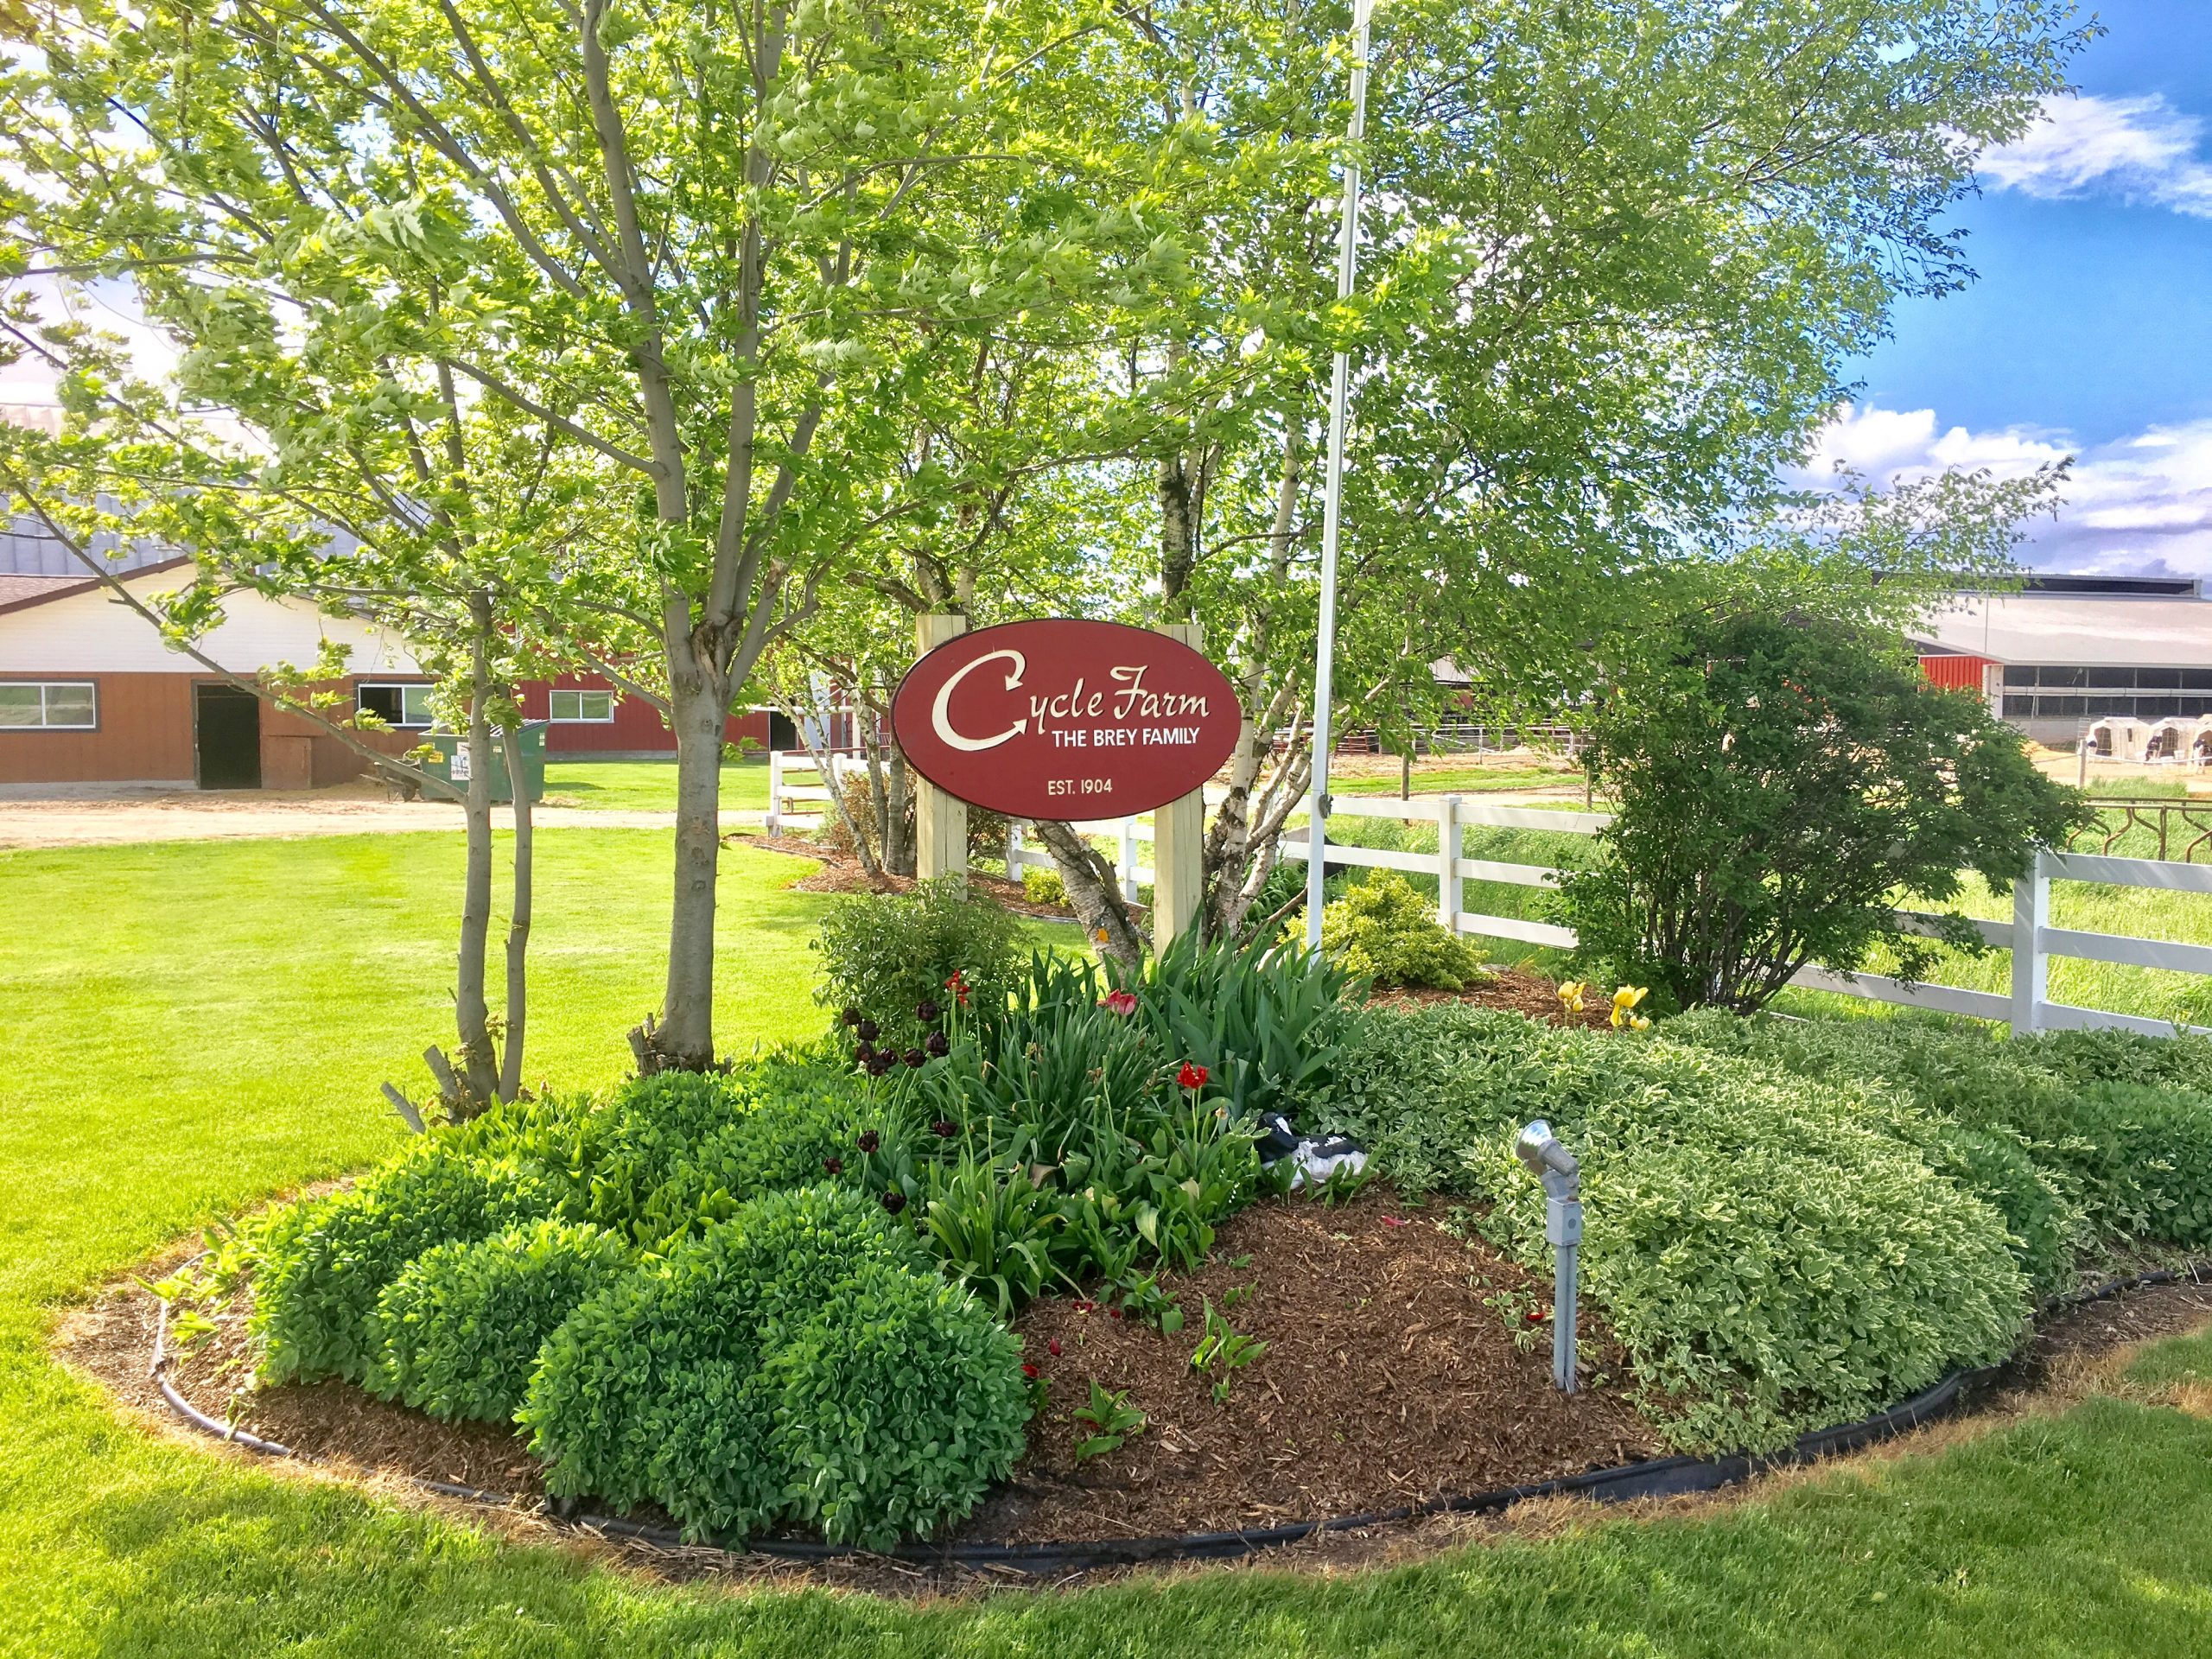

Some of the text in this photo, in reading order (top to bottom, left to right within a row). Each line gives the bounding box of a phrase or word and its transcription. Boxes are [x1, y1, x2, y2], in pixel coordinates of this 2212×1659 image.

[931, 650, 1211, 752] Cycle Farm
[1052, 727, 1200, 747] THE BREY FAMILY
[1047, 779, 1113, 796] EST. 1904
